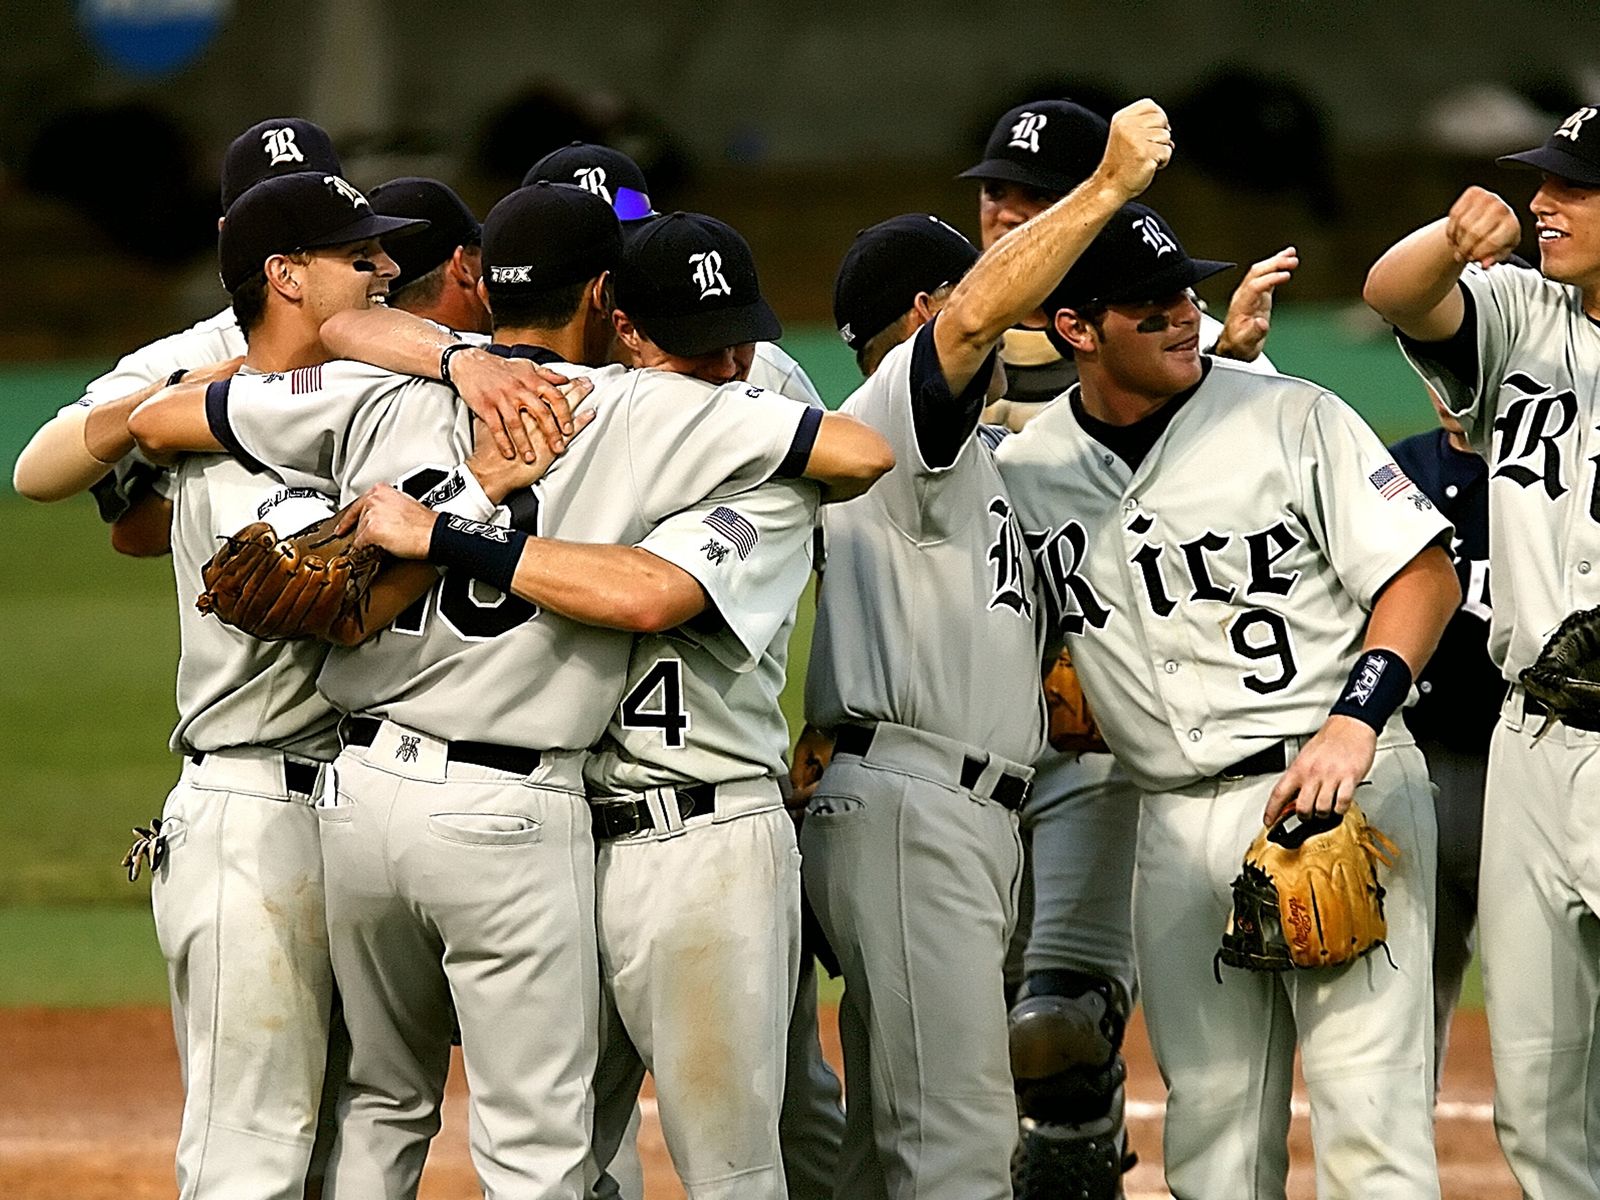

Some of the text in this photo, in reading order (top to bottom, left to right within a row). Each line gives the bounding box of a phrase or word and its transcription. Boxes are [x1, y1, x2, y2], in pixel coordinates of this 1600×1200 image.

[1007, 112, 1047, 154] R
[1553, 107, 1599, 142] R
[260, 126, 304, 168] R
[1132, 215, 1177, 258] R
[490, 265, 533, 283] TPX
[688, 250, 731, 300] R
[447, 513, 517, 543] TPX
[1022, 511, 1304, 636] Rice
[1227, 607, 1298, 696] 9
[1344, 654, 1389, 707] TPX
[620, 657, 692, 750] 4
